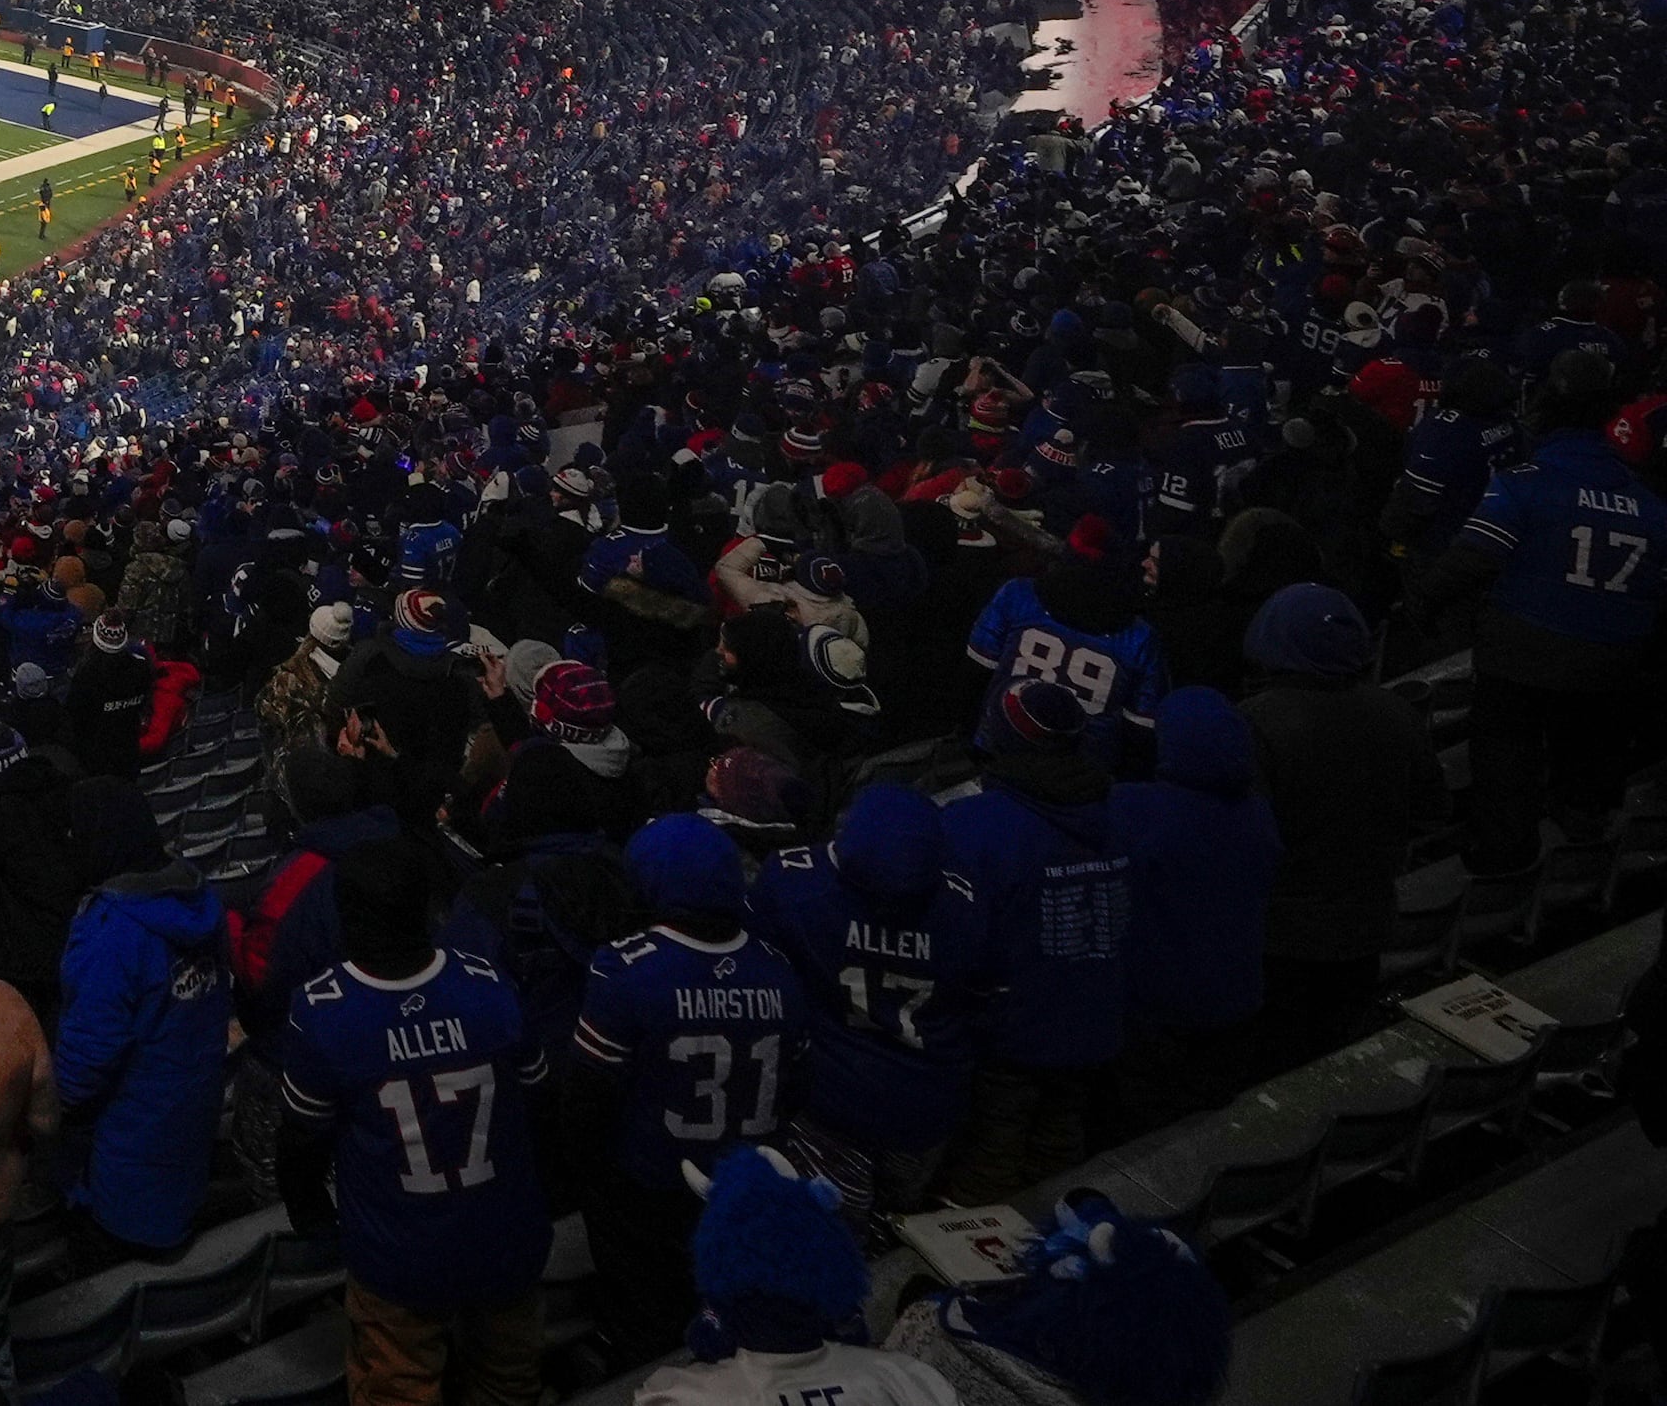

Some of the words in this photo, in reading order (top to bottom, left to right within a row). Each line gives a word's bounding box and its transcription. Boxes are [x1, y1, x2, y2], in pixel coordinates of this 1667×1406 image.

[1300, 321, 1340, 355] 99
[1162, 472, 1188, 498] 12
[1578, 488, 1640, 518] ALLEN
[1565, 525, 1649, 593] 17
[1011, 628, 1119, 715] 89
[778, 846, 813, 869] 17
[844, 920, 930, 961] ALLEN
[304, 967, 344, 1006] 17
[675, 986, 783, 1021] HAIRSTON
[839, 966, 934, 1049] 17
[386, 1017, 468, 1062] ALLEN
[663, 1033, 781, 1141] 31
[378, 1062, 497, 1196] 17
